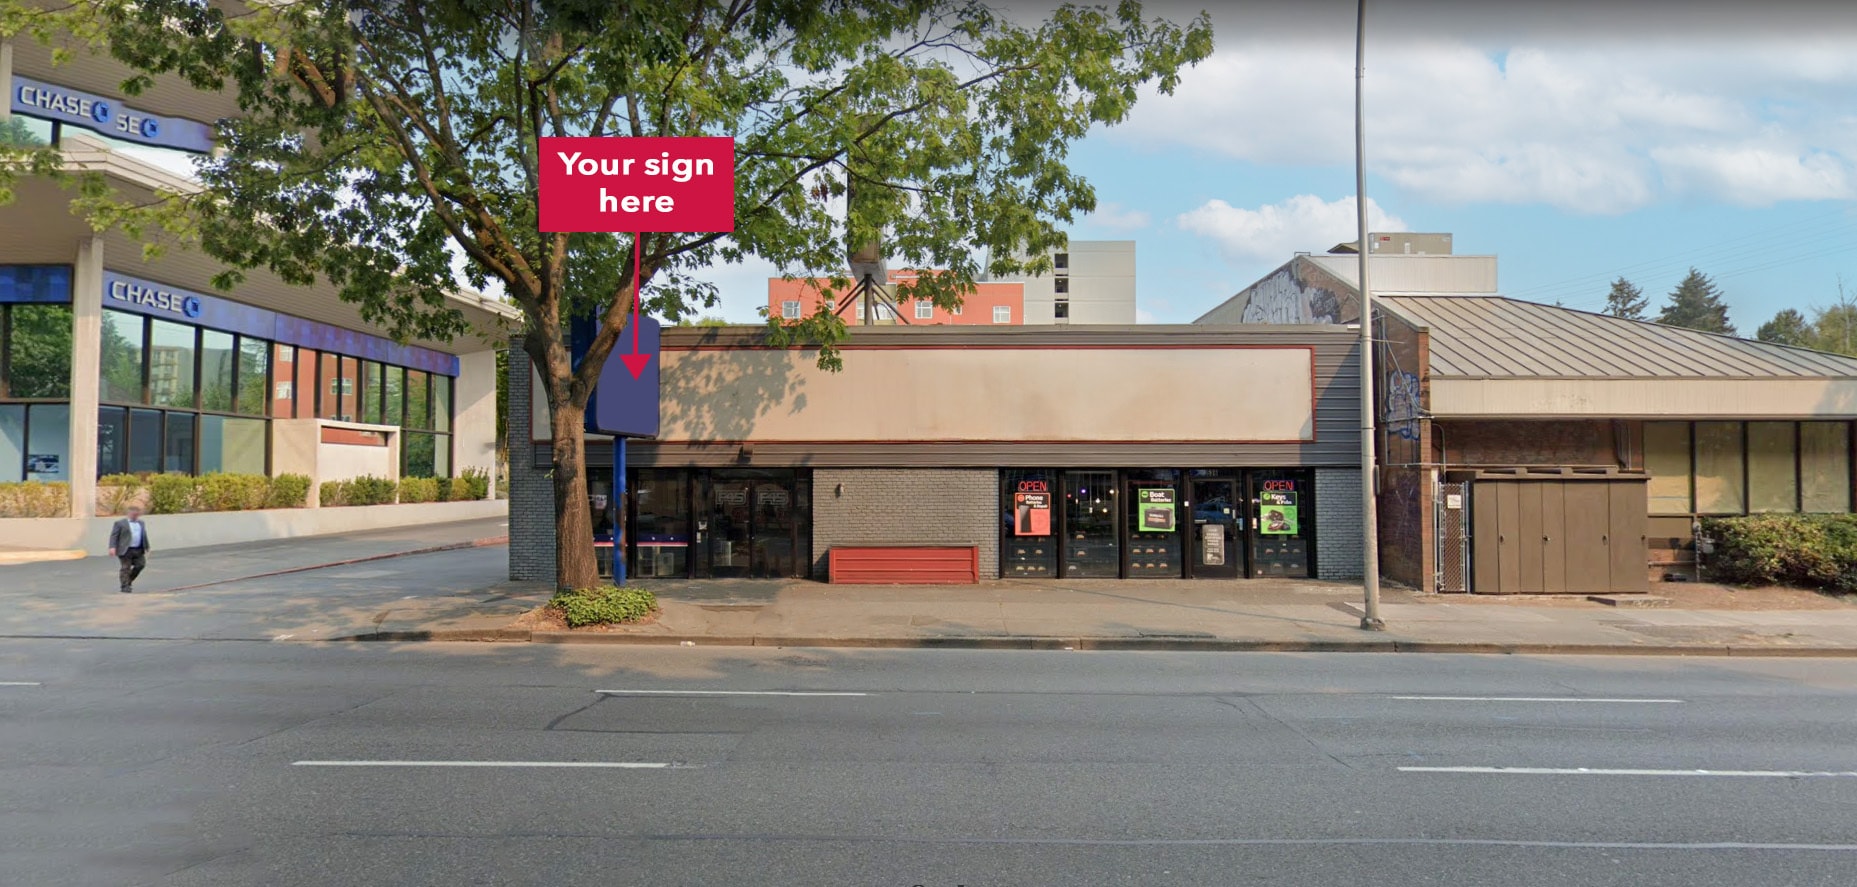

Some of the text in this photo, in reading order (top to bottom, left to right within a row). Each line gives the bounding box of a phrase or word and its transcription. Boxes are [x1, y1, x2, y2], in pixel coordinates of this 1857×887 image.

[20, 86, 92, 118] CHASE
[116, 113, 140, 135] SE
[111, 280, 182, 313] CHASE
[1019, 481, 1047, 491] OPEN
[1264, 480, 1294, 491] OPEN
